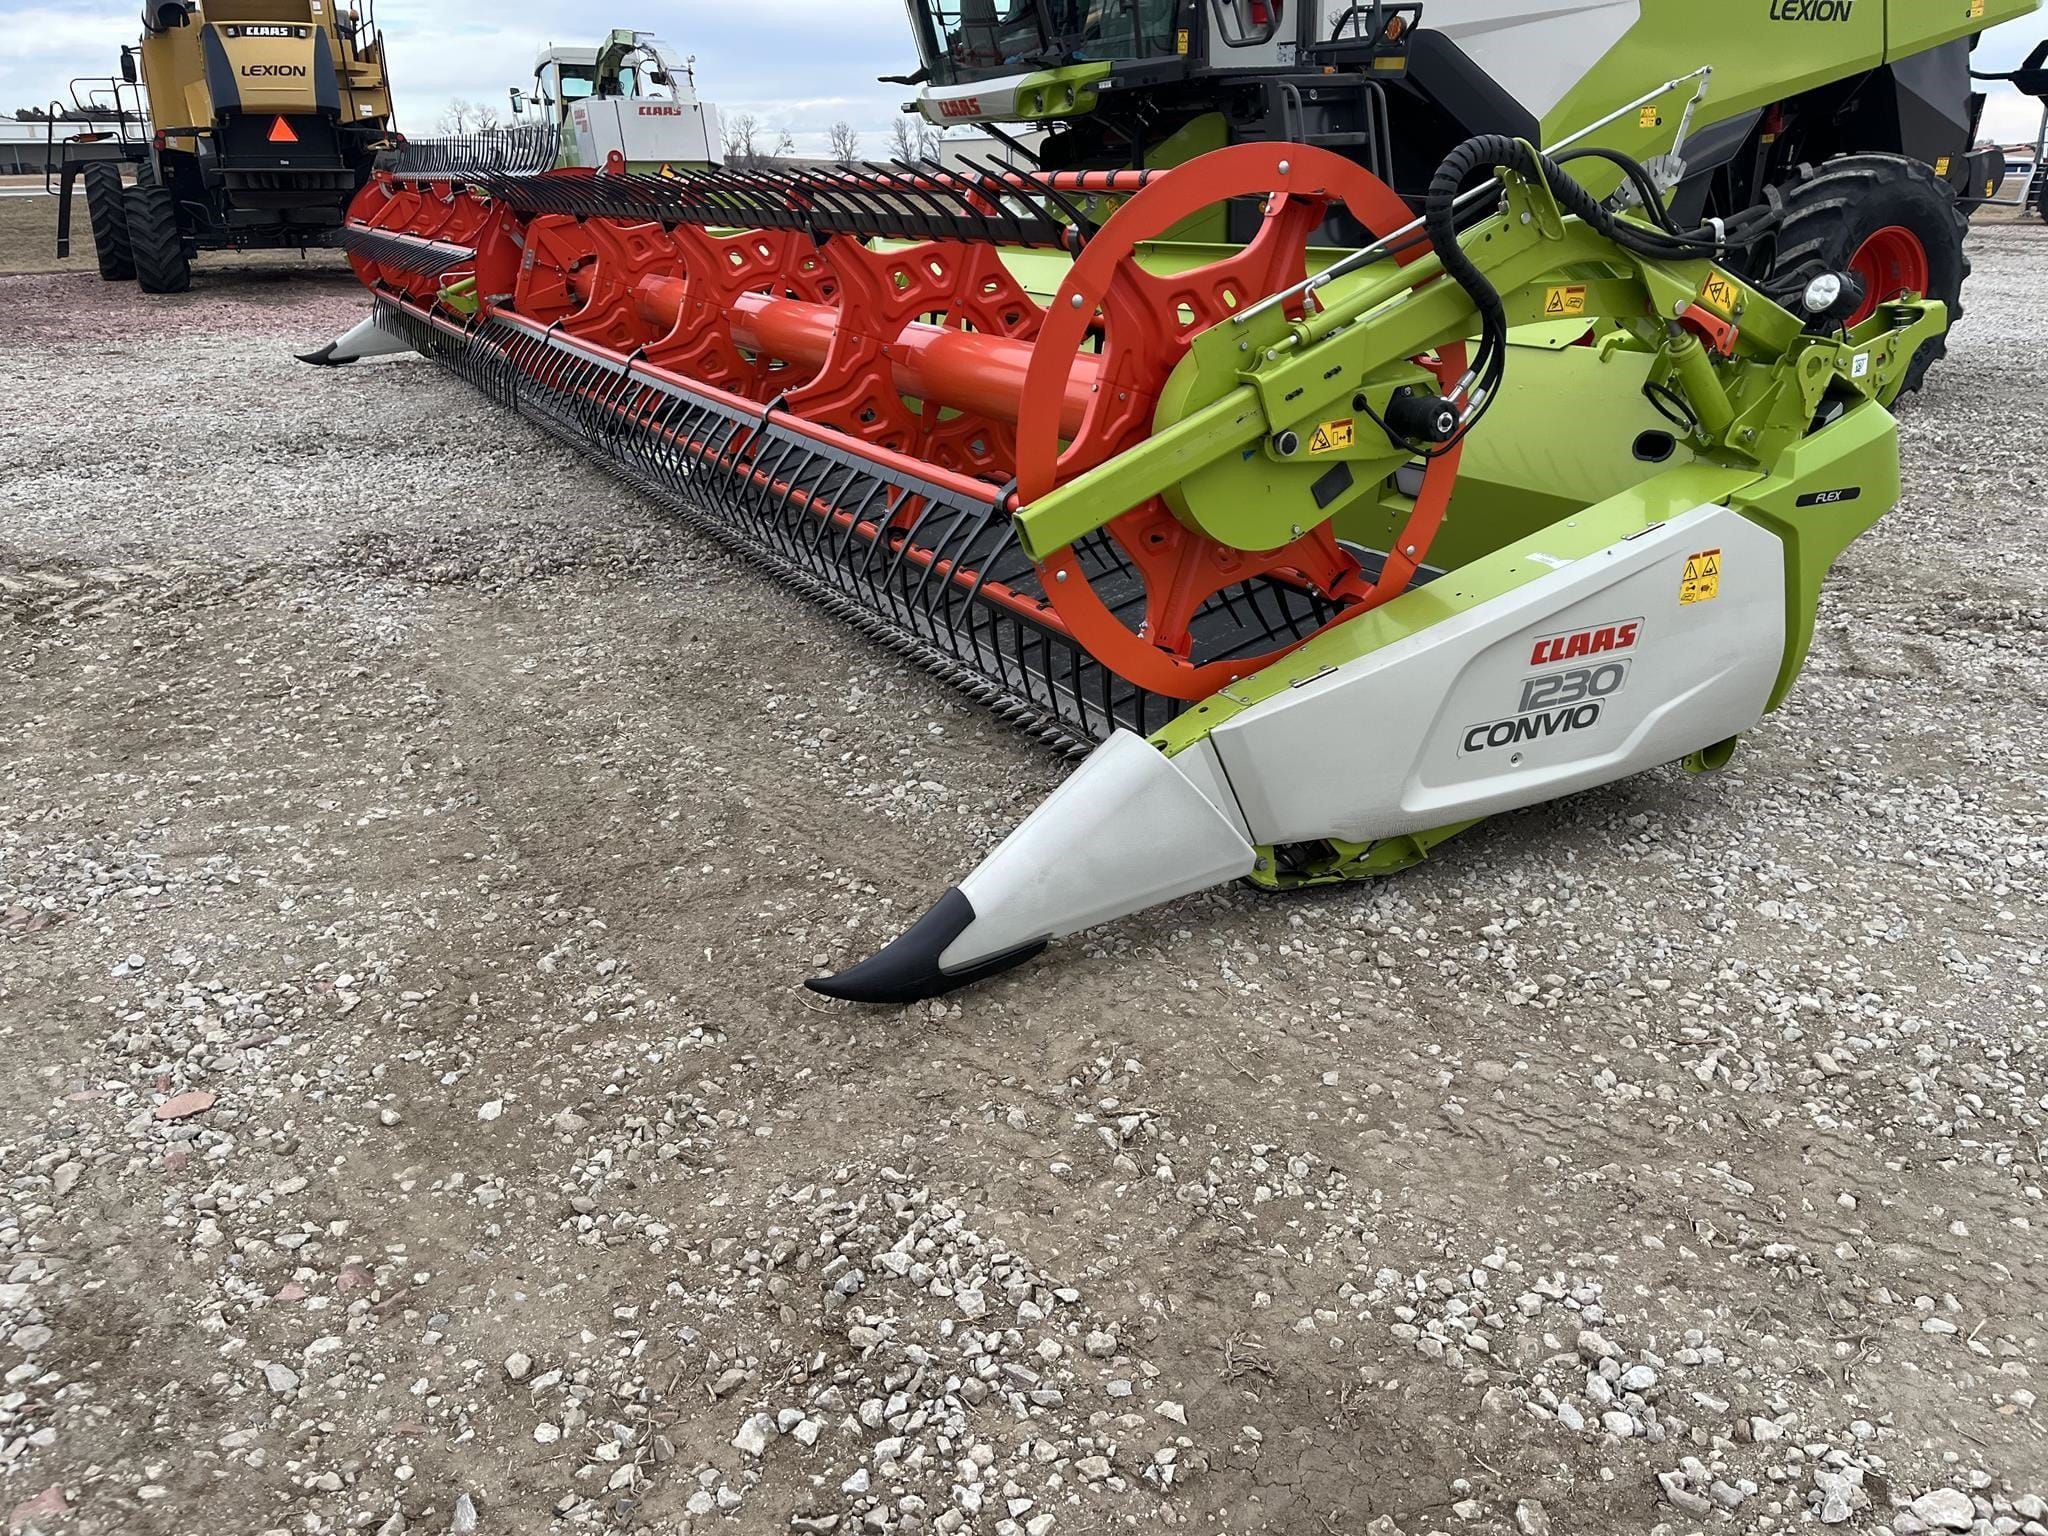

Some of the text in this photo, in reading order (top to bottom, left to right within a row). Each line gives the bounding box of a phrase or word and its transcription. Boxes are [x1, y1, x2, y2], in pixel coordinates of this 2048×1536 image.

[1769, 0, 1853, 22] LEXION
[246, 26, 288, 36] CLAAS
[241, 65, 306, 76] LEXION
[638, 106, 682, 116] CLAAS
[937, 97, 982, 117] CLAAS
[1815, 490, 1842, 504] FLEX
[1530, 622, 1638, 666] CLAAS
[1517, 663, 1625, 713] 1230
[1463, 703, 1600, 753] CONVIO
